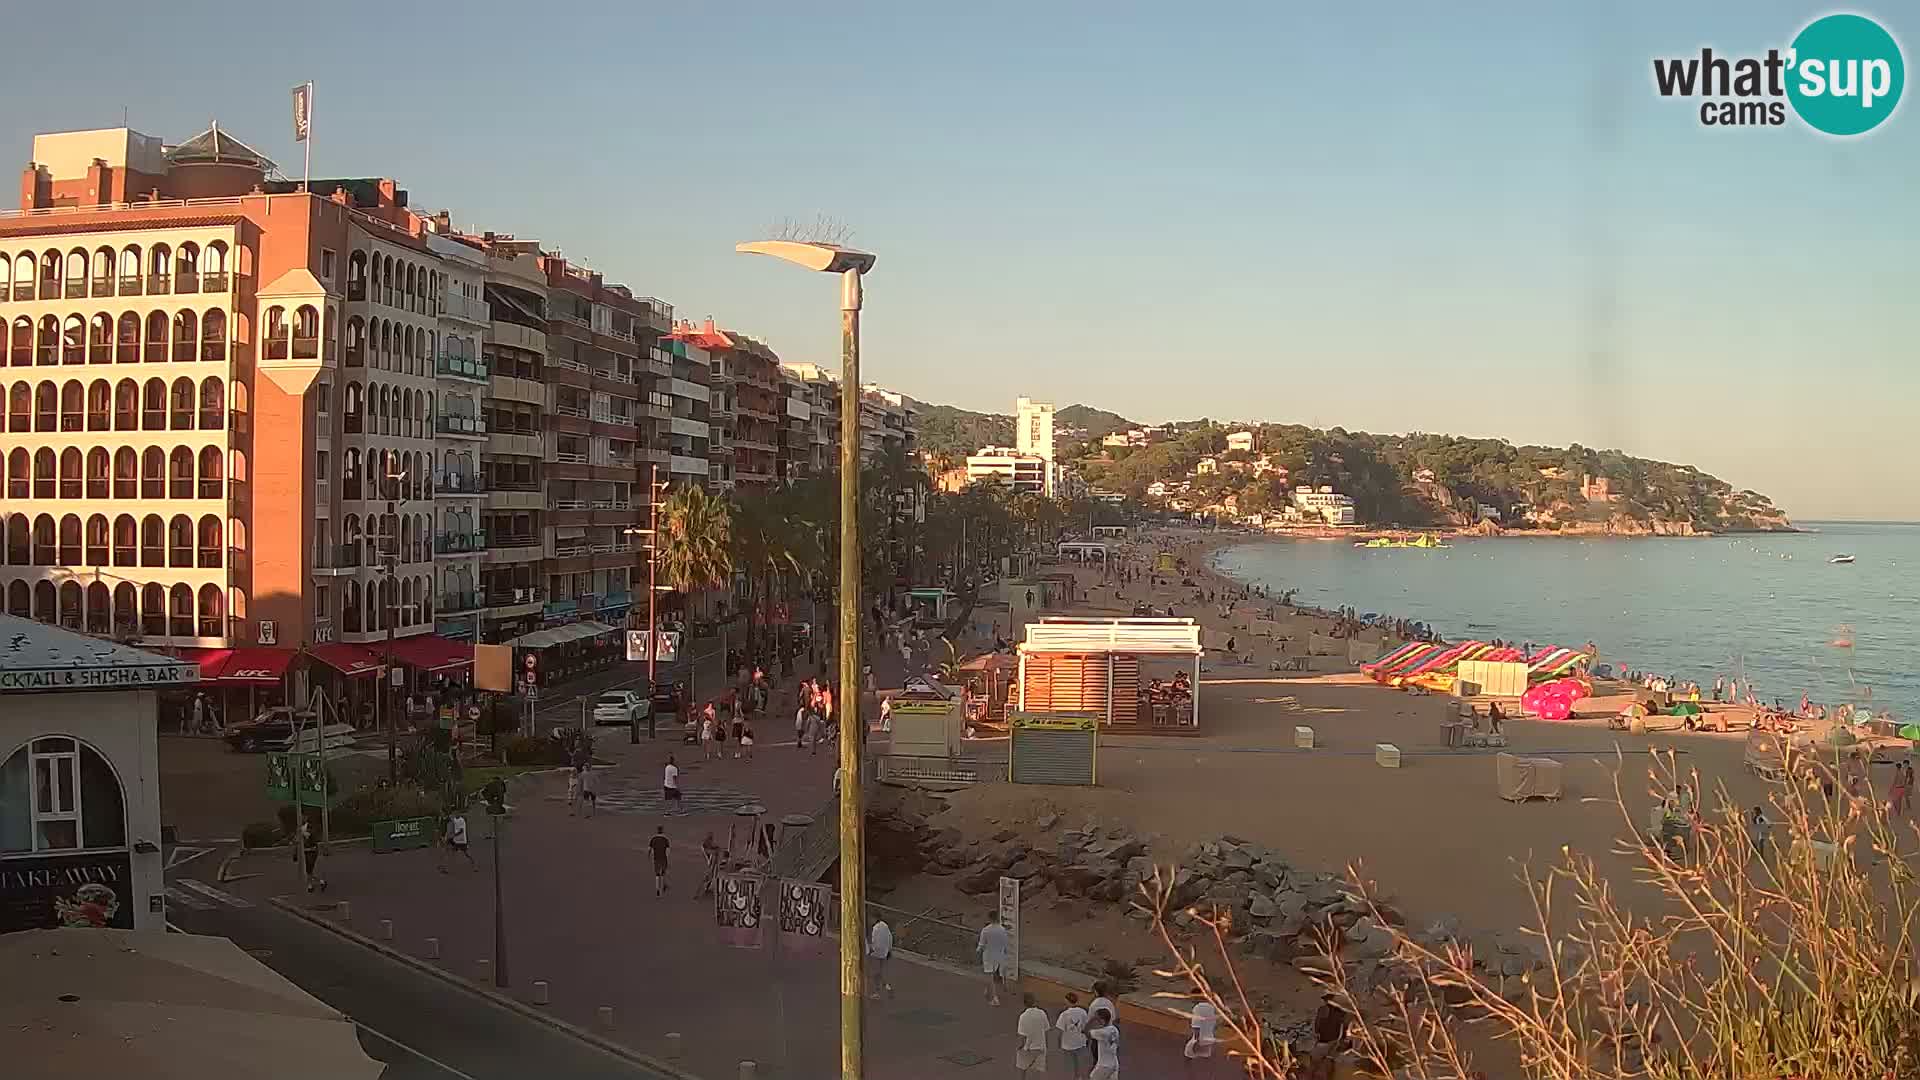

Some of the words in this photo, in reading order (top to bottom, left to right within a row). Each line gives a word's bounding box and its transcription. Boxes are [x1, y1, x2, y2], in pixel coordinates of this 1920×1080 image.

[314, 627, 333, 644] KFC
[1, 672, 61, 687] CKTAIL
[65, 672, 73, 685] &
[82, 669, 142, 685] SHISHA
[148, 667, 179, 682] BAR
[233, 669, 272, 677] KFC
